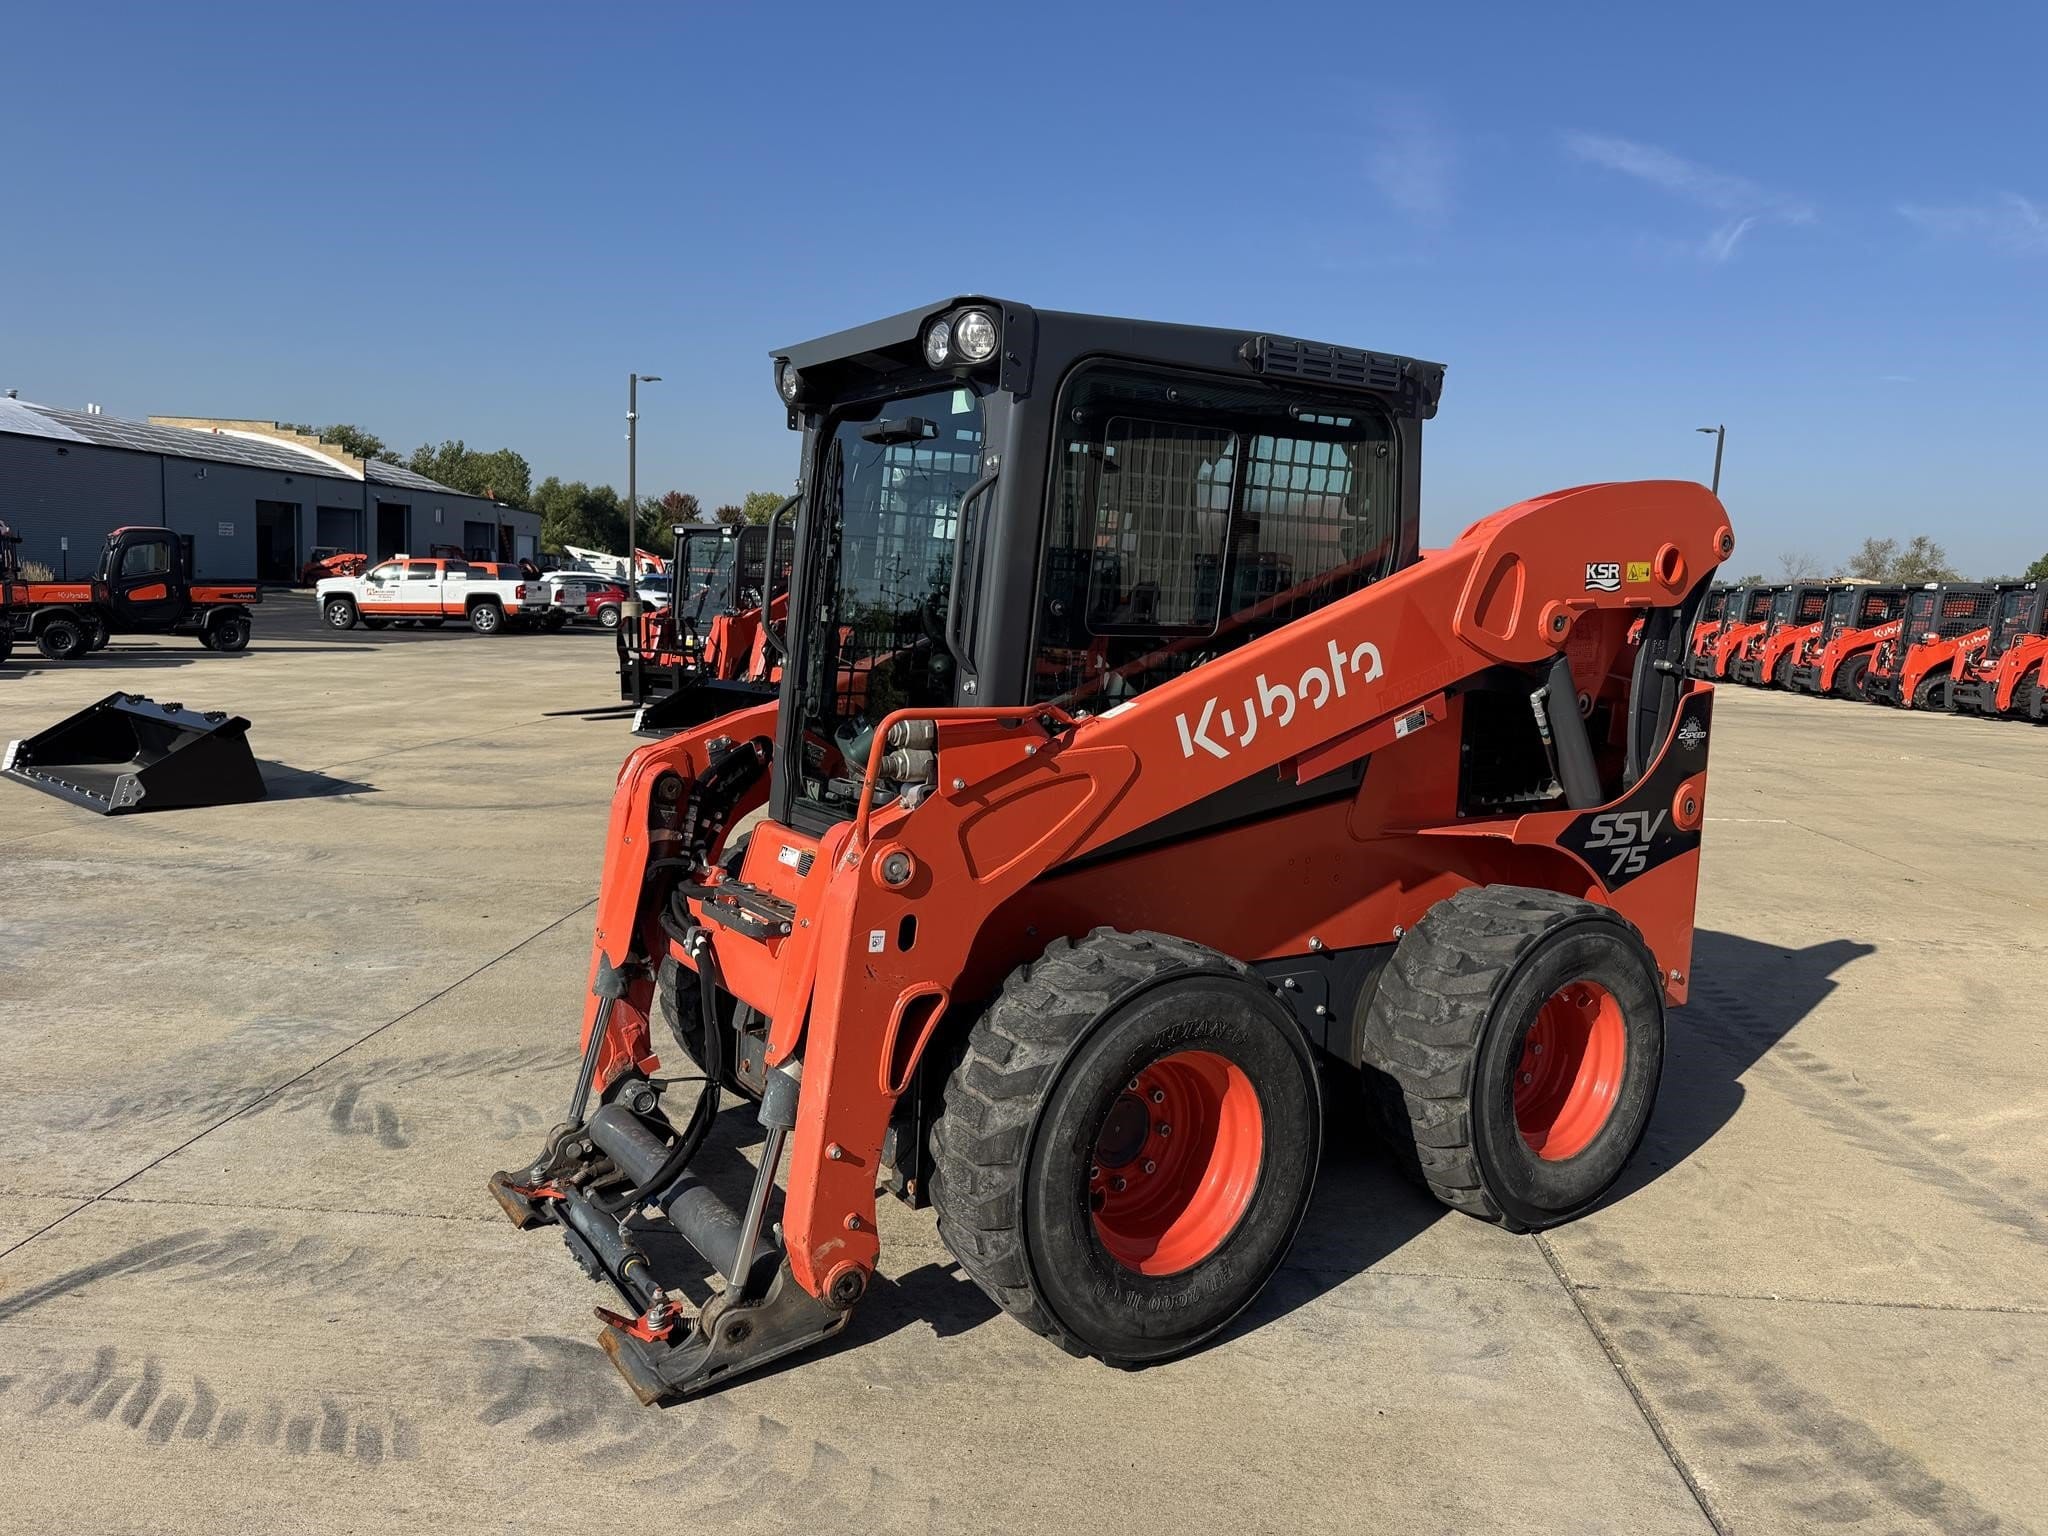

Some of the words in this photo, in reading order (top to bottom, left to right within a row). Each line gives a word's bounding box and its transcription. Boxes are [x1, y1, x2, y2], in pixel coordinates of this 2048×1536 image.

[1586, 563, 1620, 579] KSR
[57, 591, 89, 599] Kubota
[1175, 639, 1384, 759] Kubota
[1584, 808, 1668, 849] SSV
[1607, 844, 1650, 876] 75
